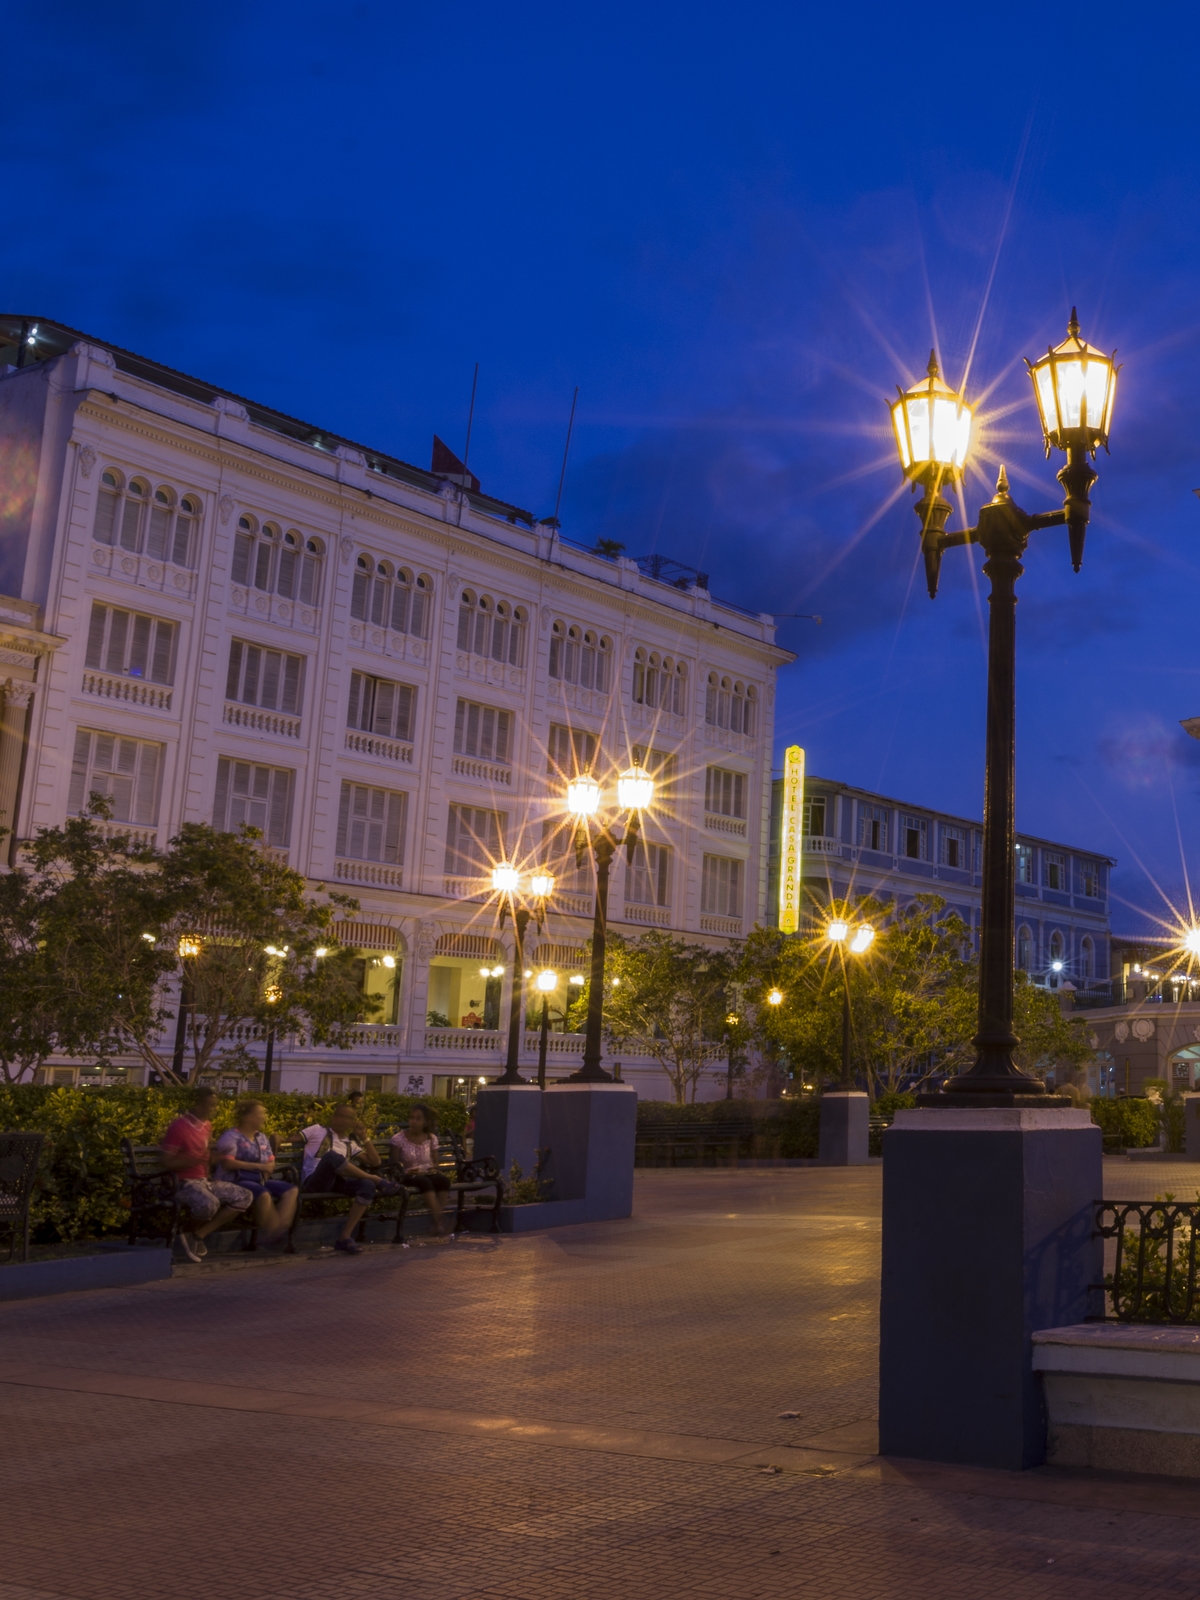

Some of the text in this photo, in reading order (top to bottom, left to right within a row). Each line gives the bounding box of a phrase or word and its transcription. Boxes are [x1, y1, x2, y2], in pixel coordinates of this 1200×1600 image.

[786, 768, 798, 910] HOTEL CASA GRANDA
